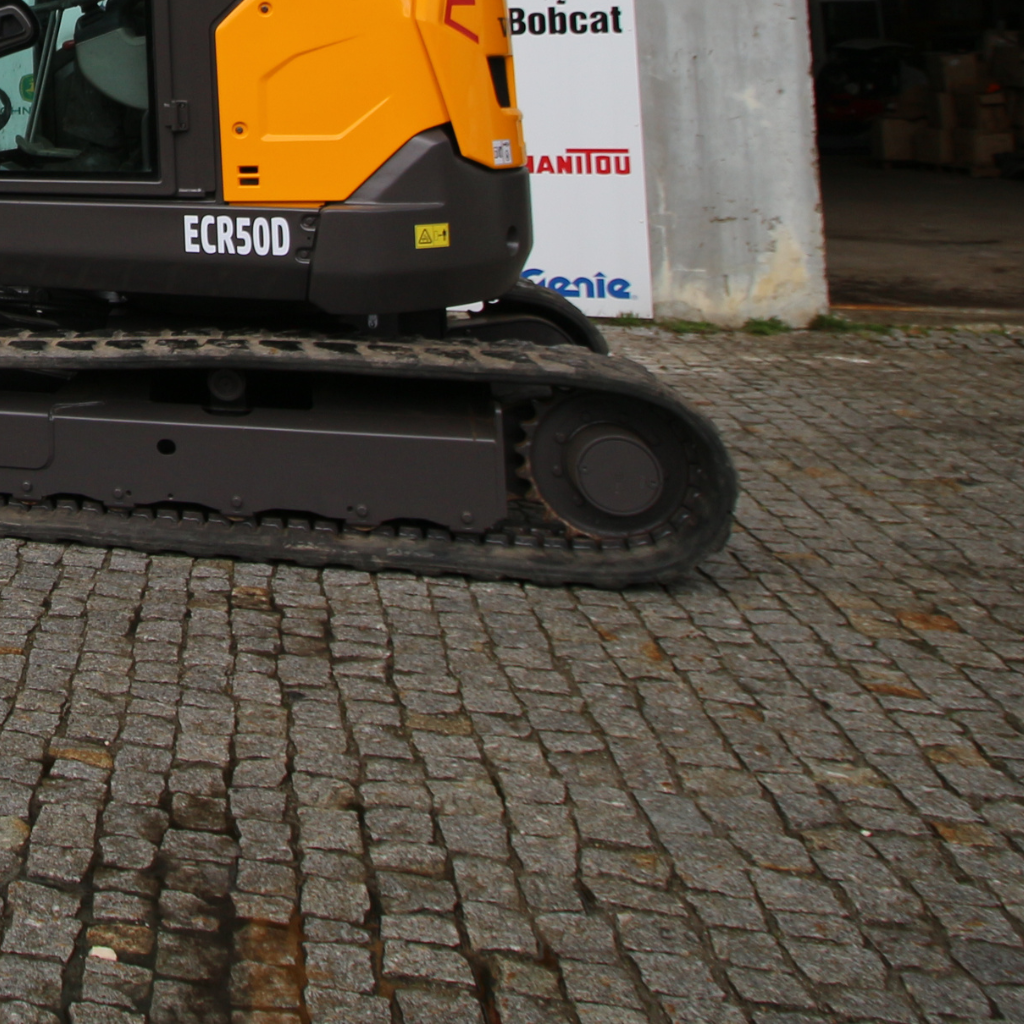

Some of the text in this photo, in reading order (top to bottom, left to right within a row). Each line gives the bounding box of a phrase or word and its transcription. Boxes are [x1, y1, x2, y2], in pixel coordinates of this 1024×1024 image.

[508, 6, 623, 36] Bobcat
[183, 214, 291, 256] ECR50D
[521, 268, 631, 300] Genie
